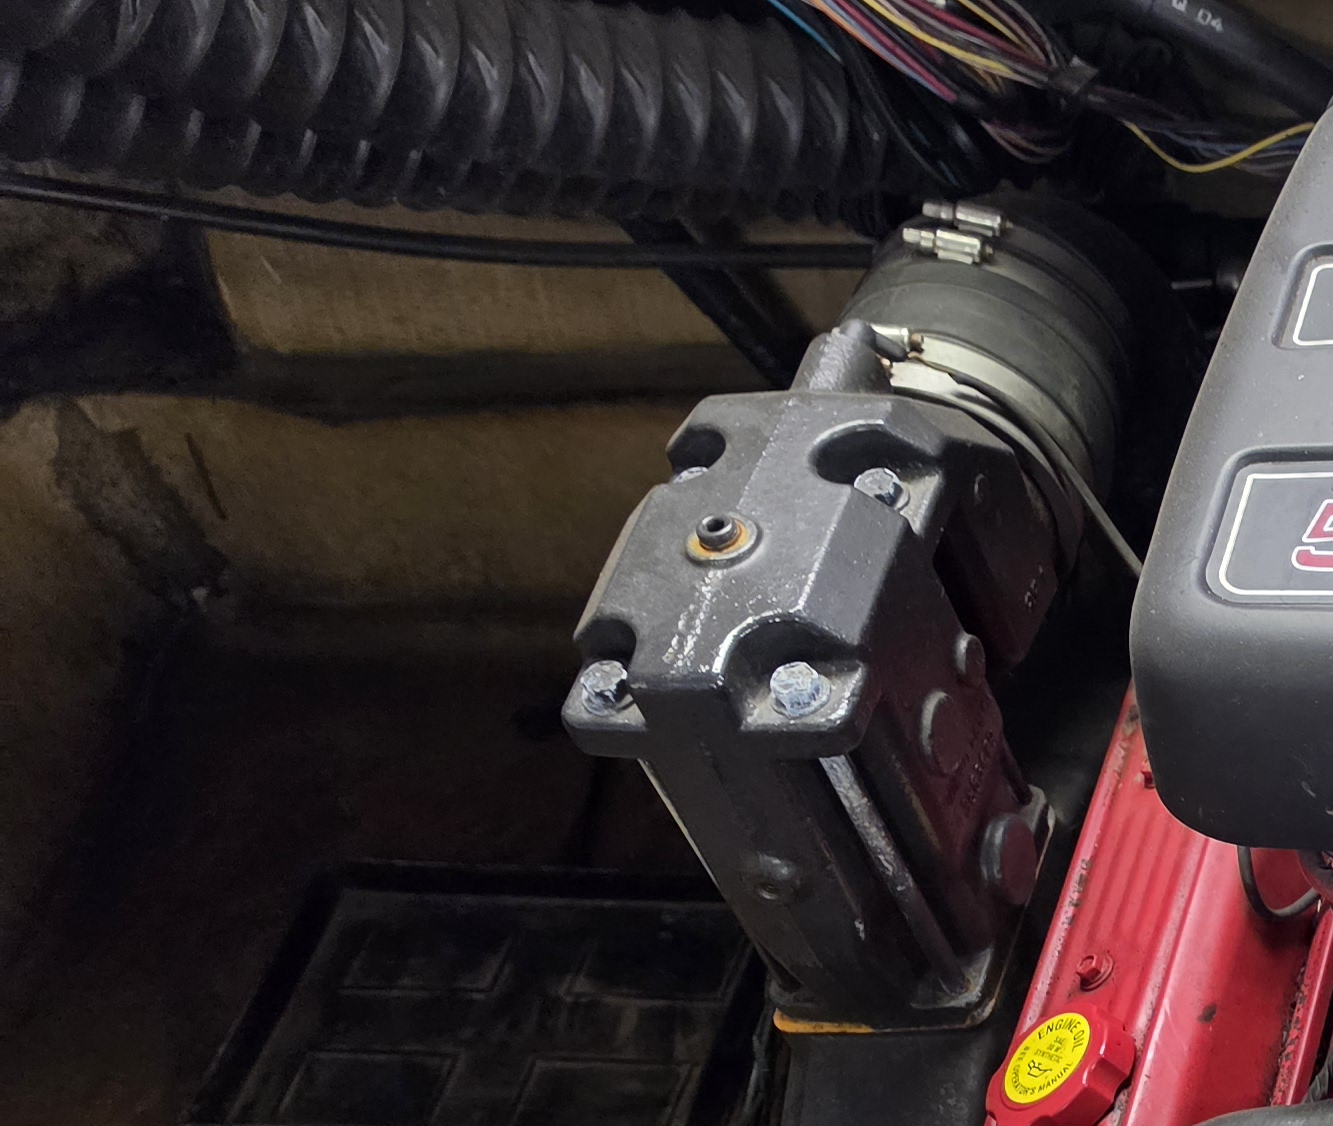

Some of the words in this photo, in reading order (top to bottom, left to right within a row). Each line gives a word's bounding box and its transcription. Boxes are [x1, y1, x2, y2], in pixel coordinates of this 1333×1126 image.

[1038, 1018, 1081, 1040] ENGINE
[1072, 1030, 1085, 1052] OIL
[1038, 1062, 1073, 1092] MANUAL
